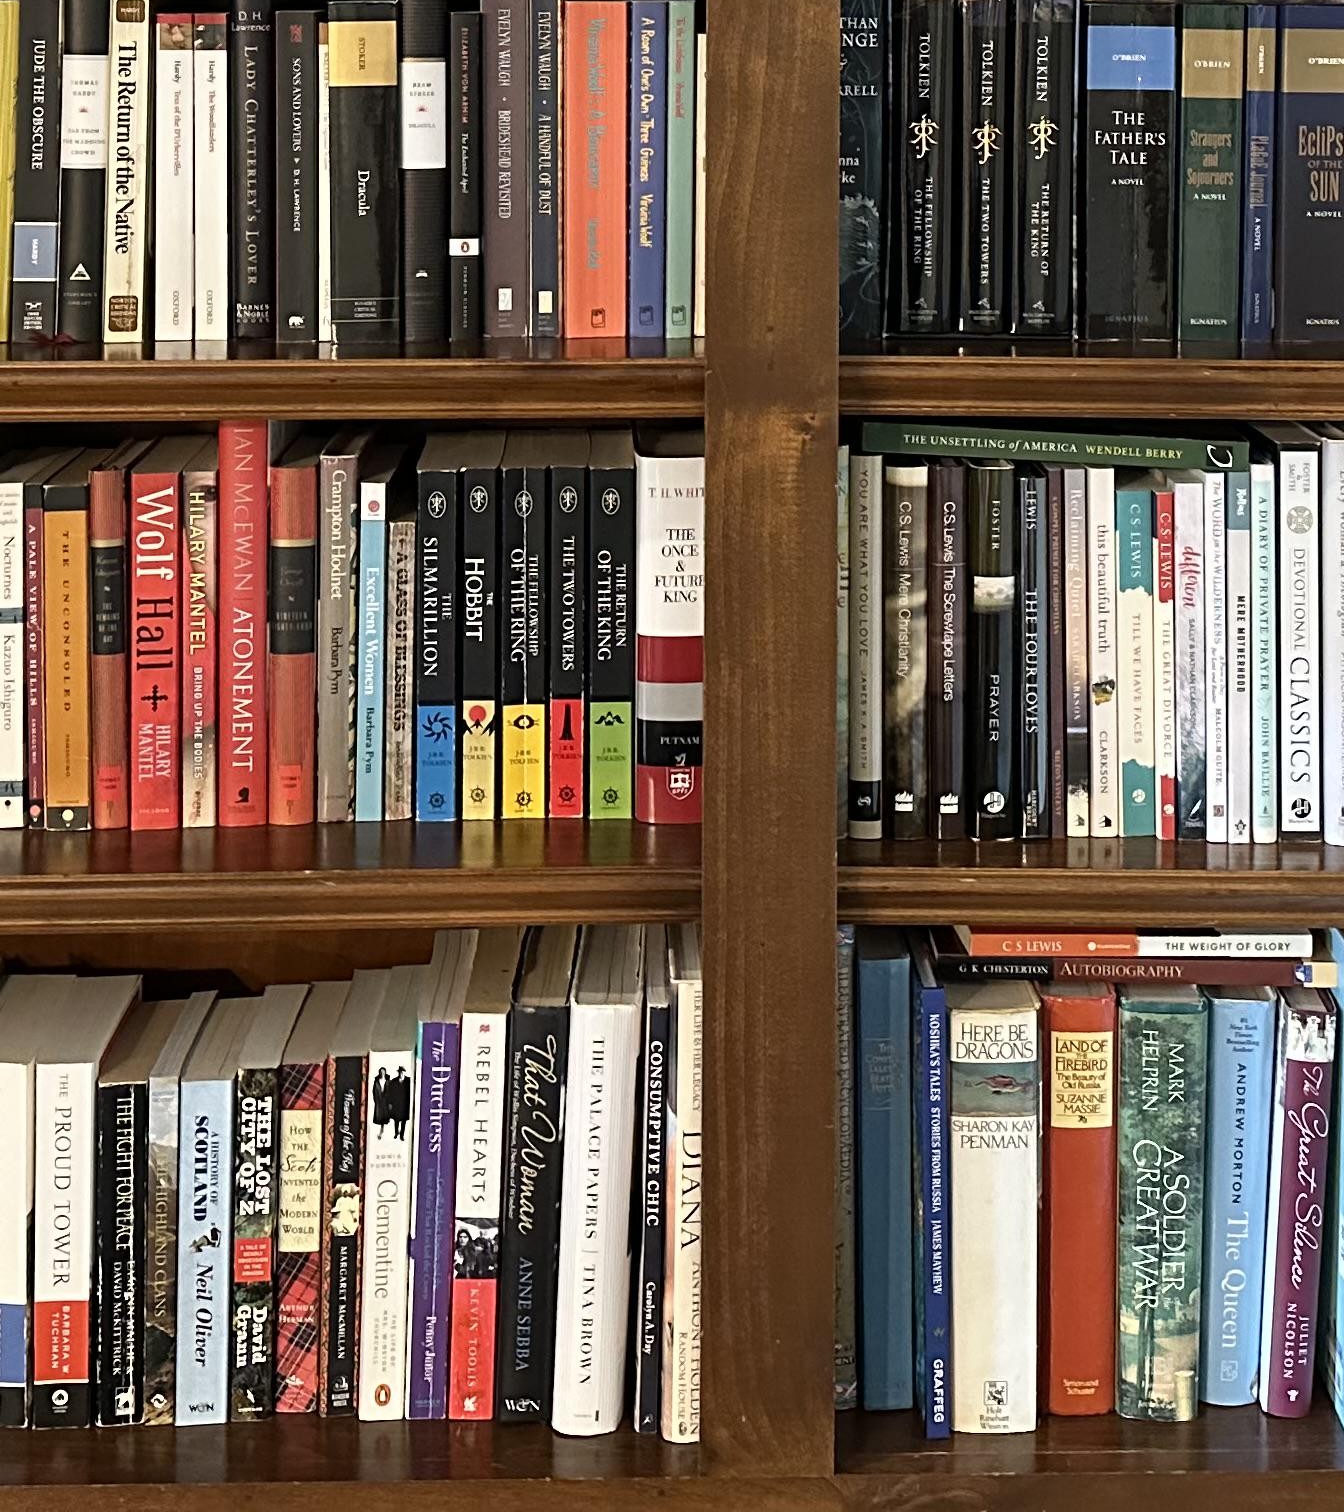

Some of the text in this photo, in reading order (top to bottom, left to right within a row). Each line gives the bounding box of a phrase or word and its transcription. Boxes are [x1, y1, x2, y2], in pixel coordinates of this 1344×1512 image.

[919, 34, 931, 99] TOLKIEN
[31, 40, 46, 170] JUDE THE OBSCURE
[1095, 130, 1166, 146] FATHER'S
[1112, 110, 1145, 126] THE
[115, 41, 137, 255] The Return of the Native
[1110, 150, 1148, 165] TALE
[357, 170, 371, 217] Dracula
[904, 434, 1182, 459] THE UNSETTLING of AMERICA WENDELL BERRY
[135, 487, 174, 672] Wolf Hall
[423, 537, 440, 677] SILMARILLION
[465, 557, 485, 642] HOBBIT
[232, 607, 253, 772] ATONEMENT
[1289, 549, 1311, 784] DEVOTIONAL CLASSICS
[989, 674, 1000, 742] PRAYER
[1026, 940, 1062, 952] LEWIS
[1060, 963, 1184, 978] AUTOBIOGRAPHY
[1165, 941, 1292, 952] THE WEIGHT OF GLORY
[955, 1042, 1033, 1060] DRAGONS
[960, 1023, 1028, 1042] HERE BE
[472, 1046, 490, 1205] REBEL HEARTS
[53, 1074, 72, 1287] THE PROUD TOWER
[1221, 1212, 1250, 1348] The Queen
[194, 1264, 213, 1367] Neil Oliver
